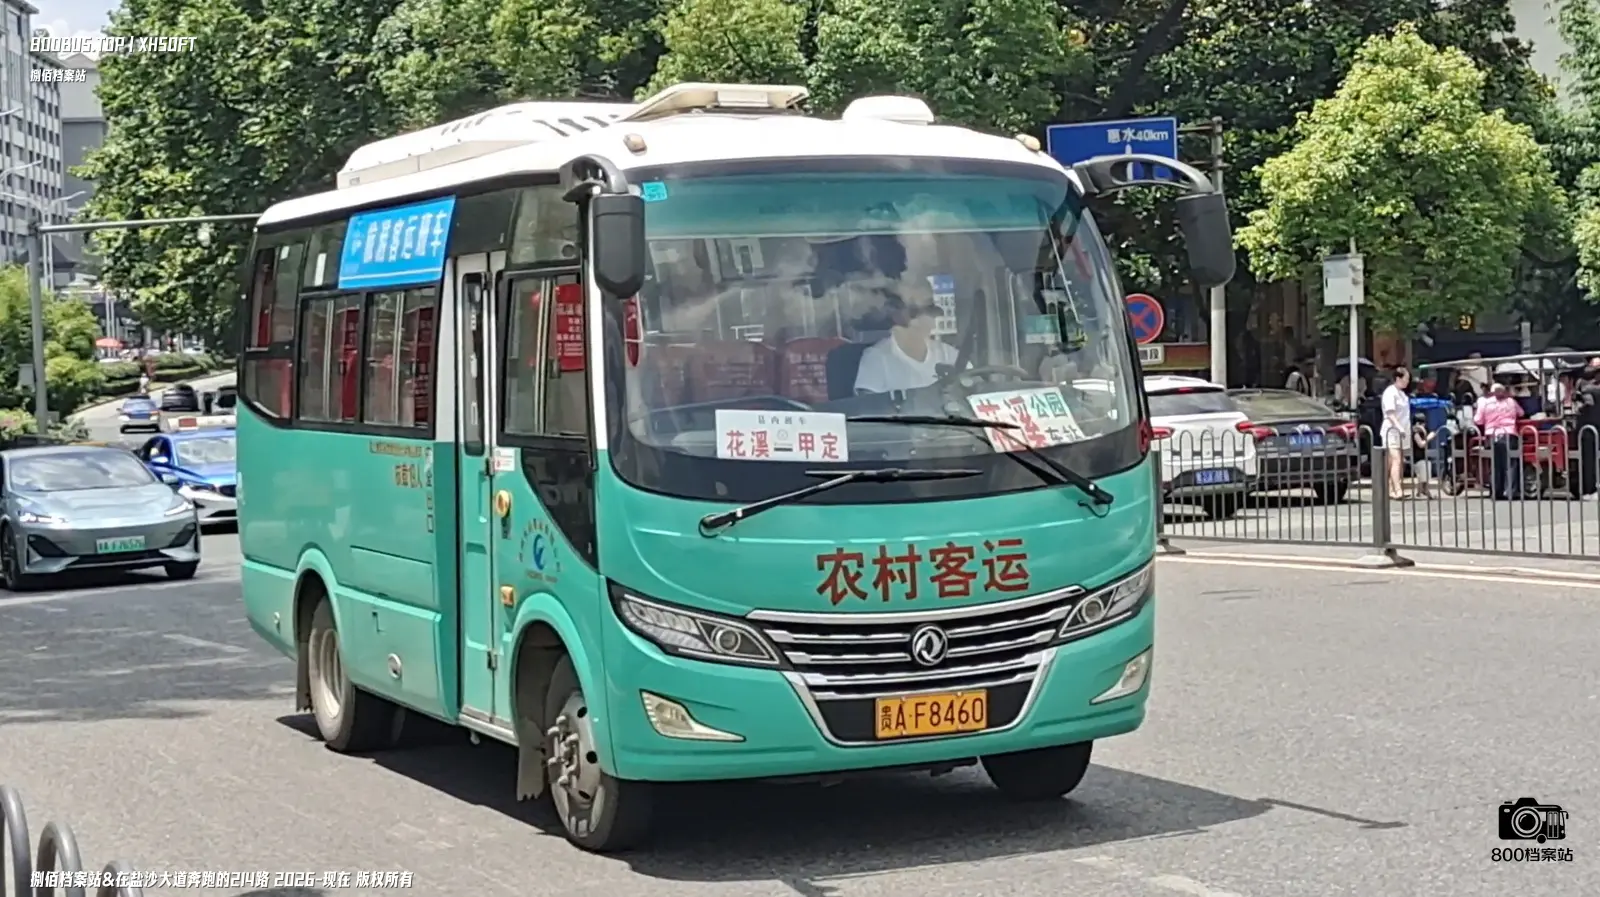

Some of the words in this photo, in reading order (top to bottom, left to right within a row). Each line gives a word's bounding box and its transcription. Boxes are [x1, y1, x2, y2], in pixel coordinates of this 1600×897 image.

[1107, 128, 1169, 144] 惠水40km
[1030, 391, 1068, 417] 公园
[816, 538, 1030, 606] 农村客运
